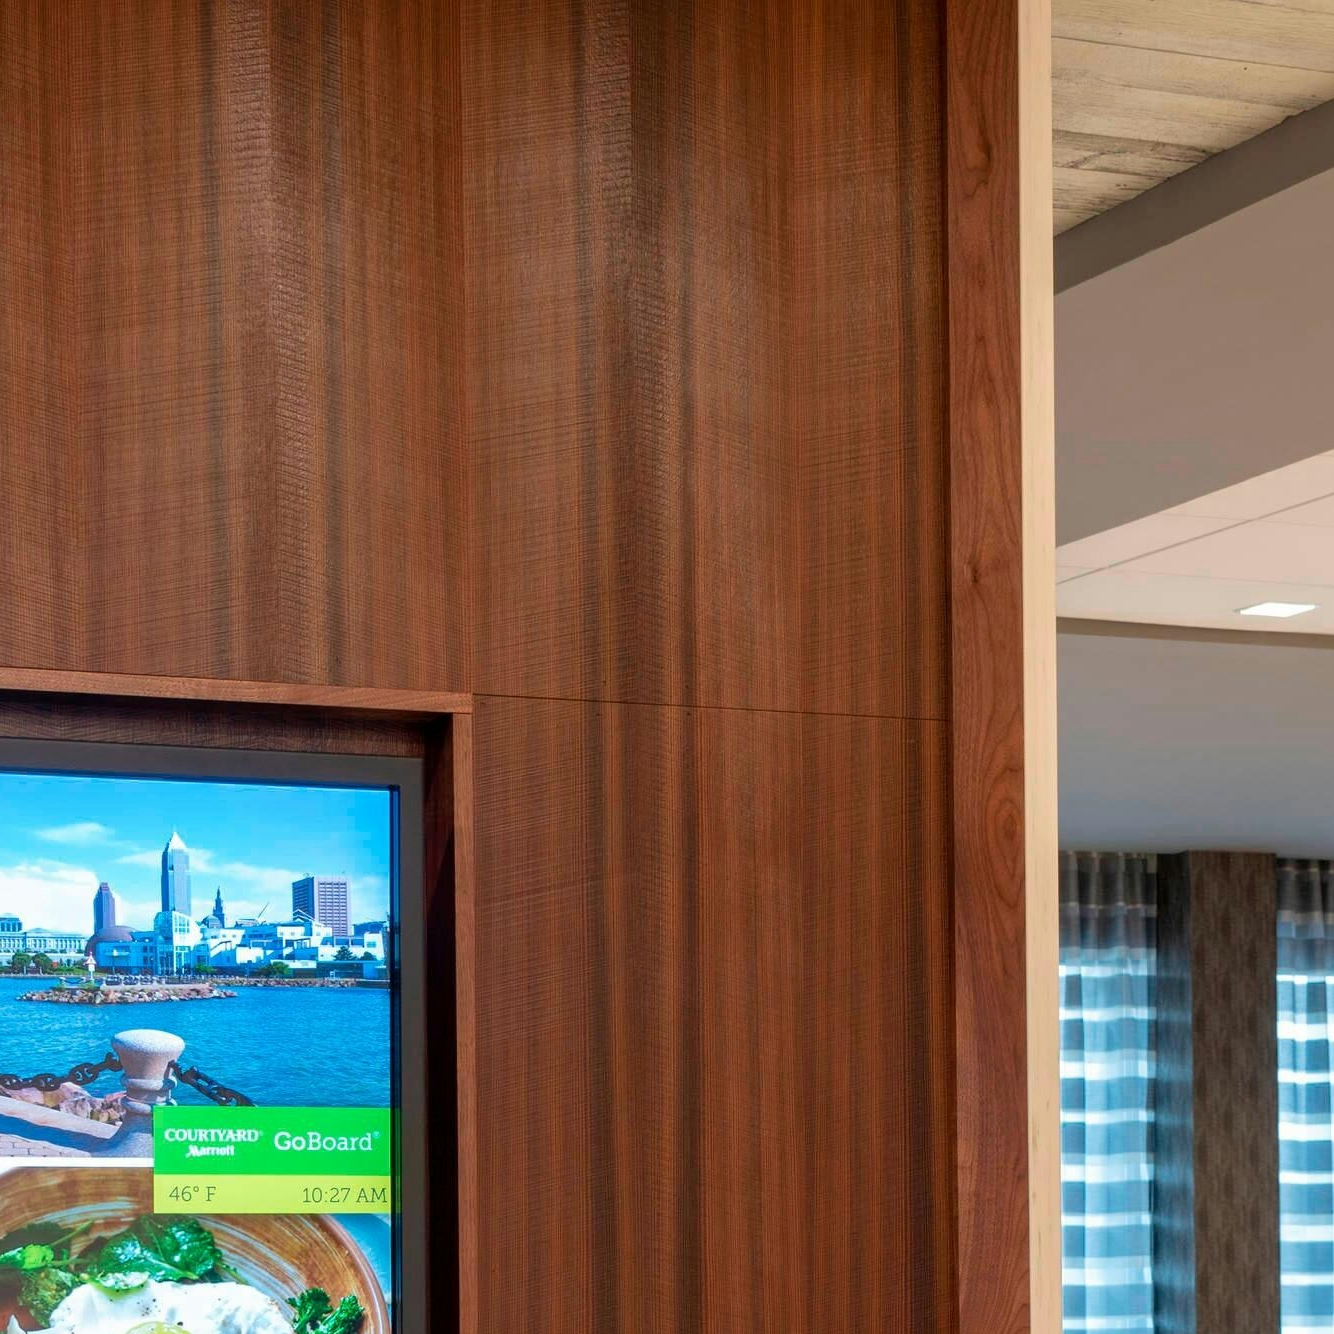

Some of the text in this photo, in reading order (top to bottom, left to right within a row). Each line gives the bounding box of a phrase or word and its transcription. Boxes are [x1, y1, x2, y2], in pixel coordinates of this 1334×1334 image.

[168, 1186, 217, 1202] 46° F
[302, 1187, 388, 1204] 10:27 AM
